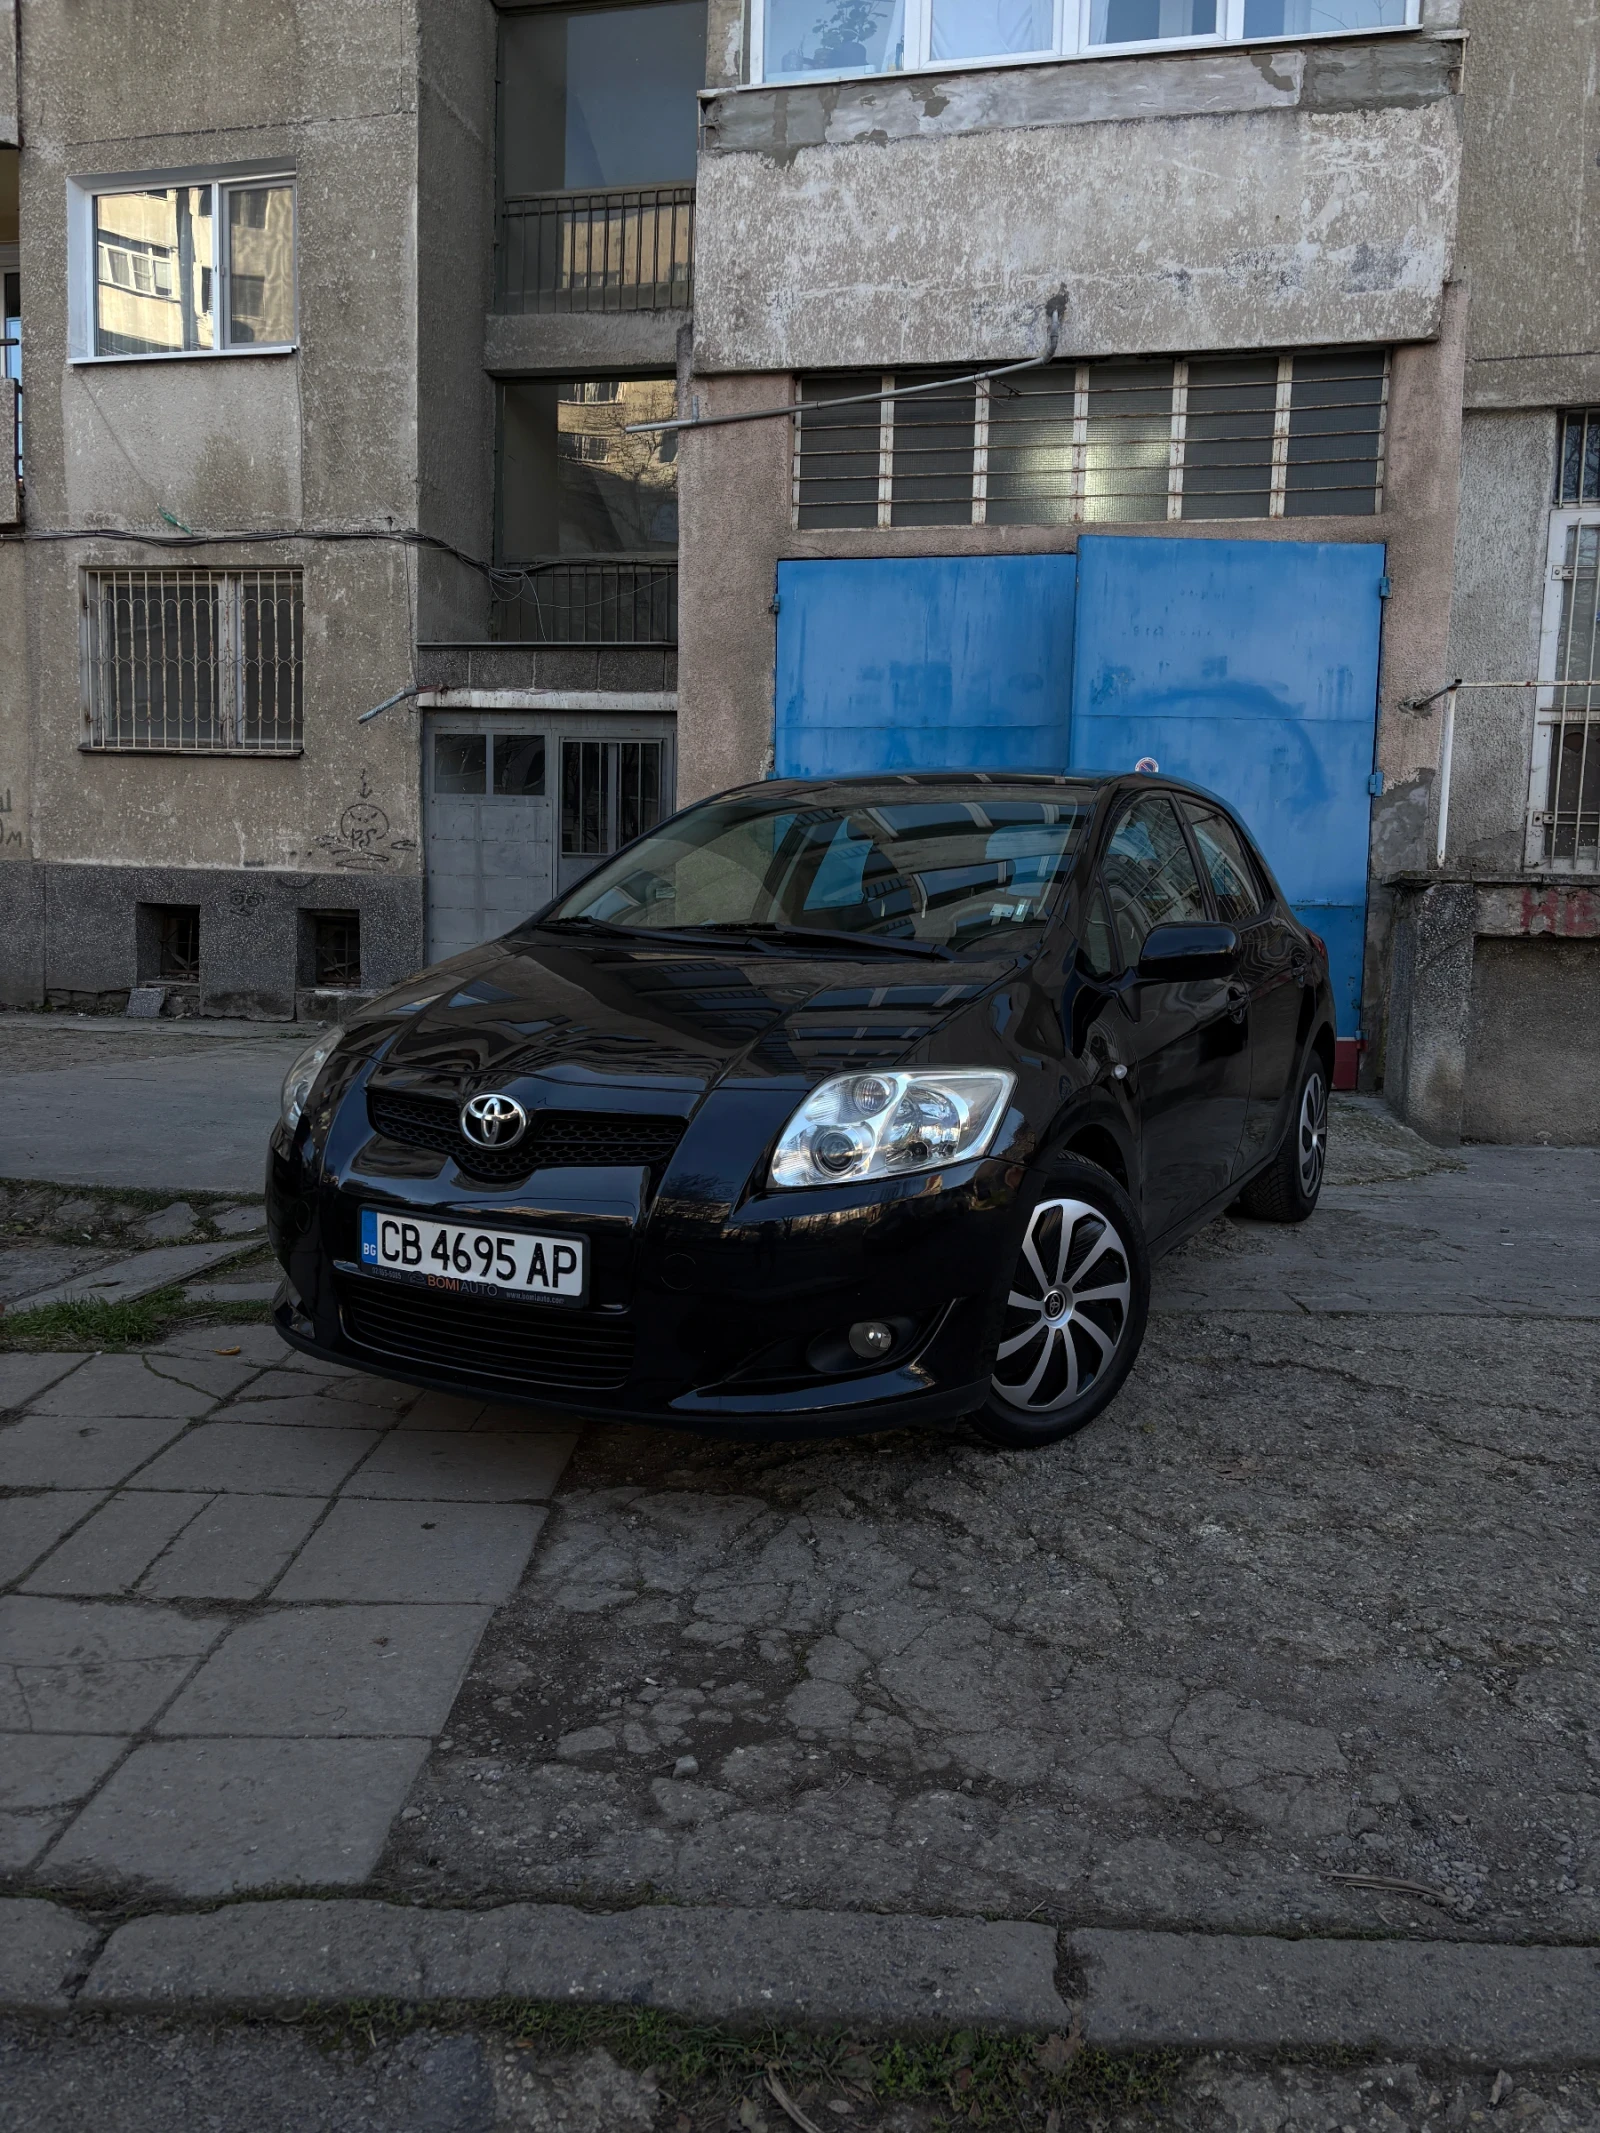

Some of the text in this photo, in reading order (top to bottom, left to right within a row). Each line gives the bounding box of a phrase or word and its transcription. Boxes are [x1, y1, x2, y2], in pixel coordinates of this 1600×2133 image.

[362, 1242, 377, 1256] BG
[382, 1220, 577, 1288] CB 4695 AP
